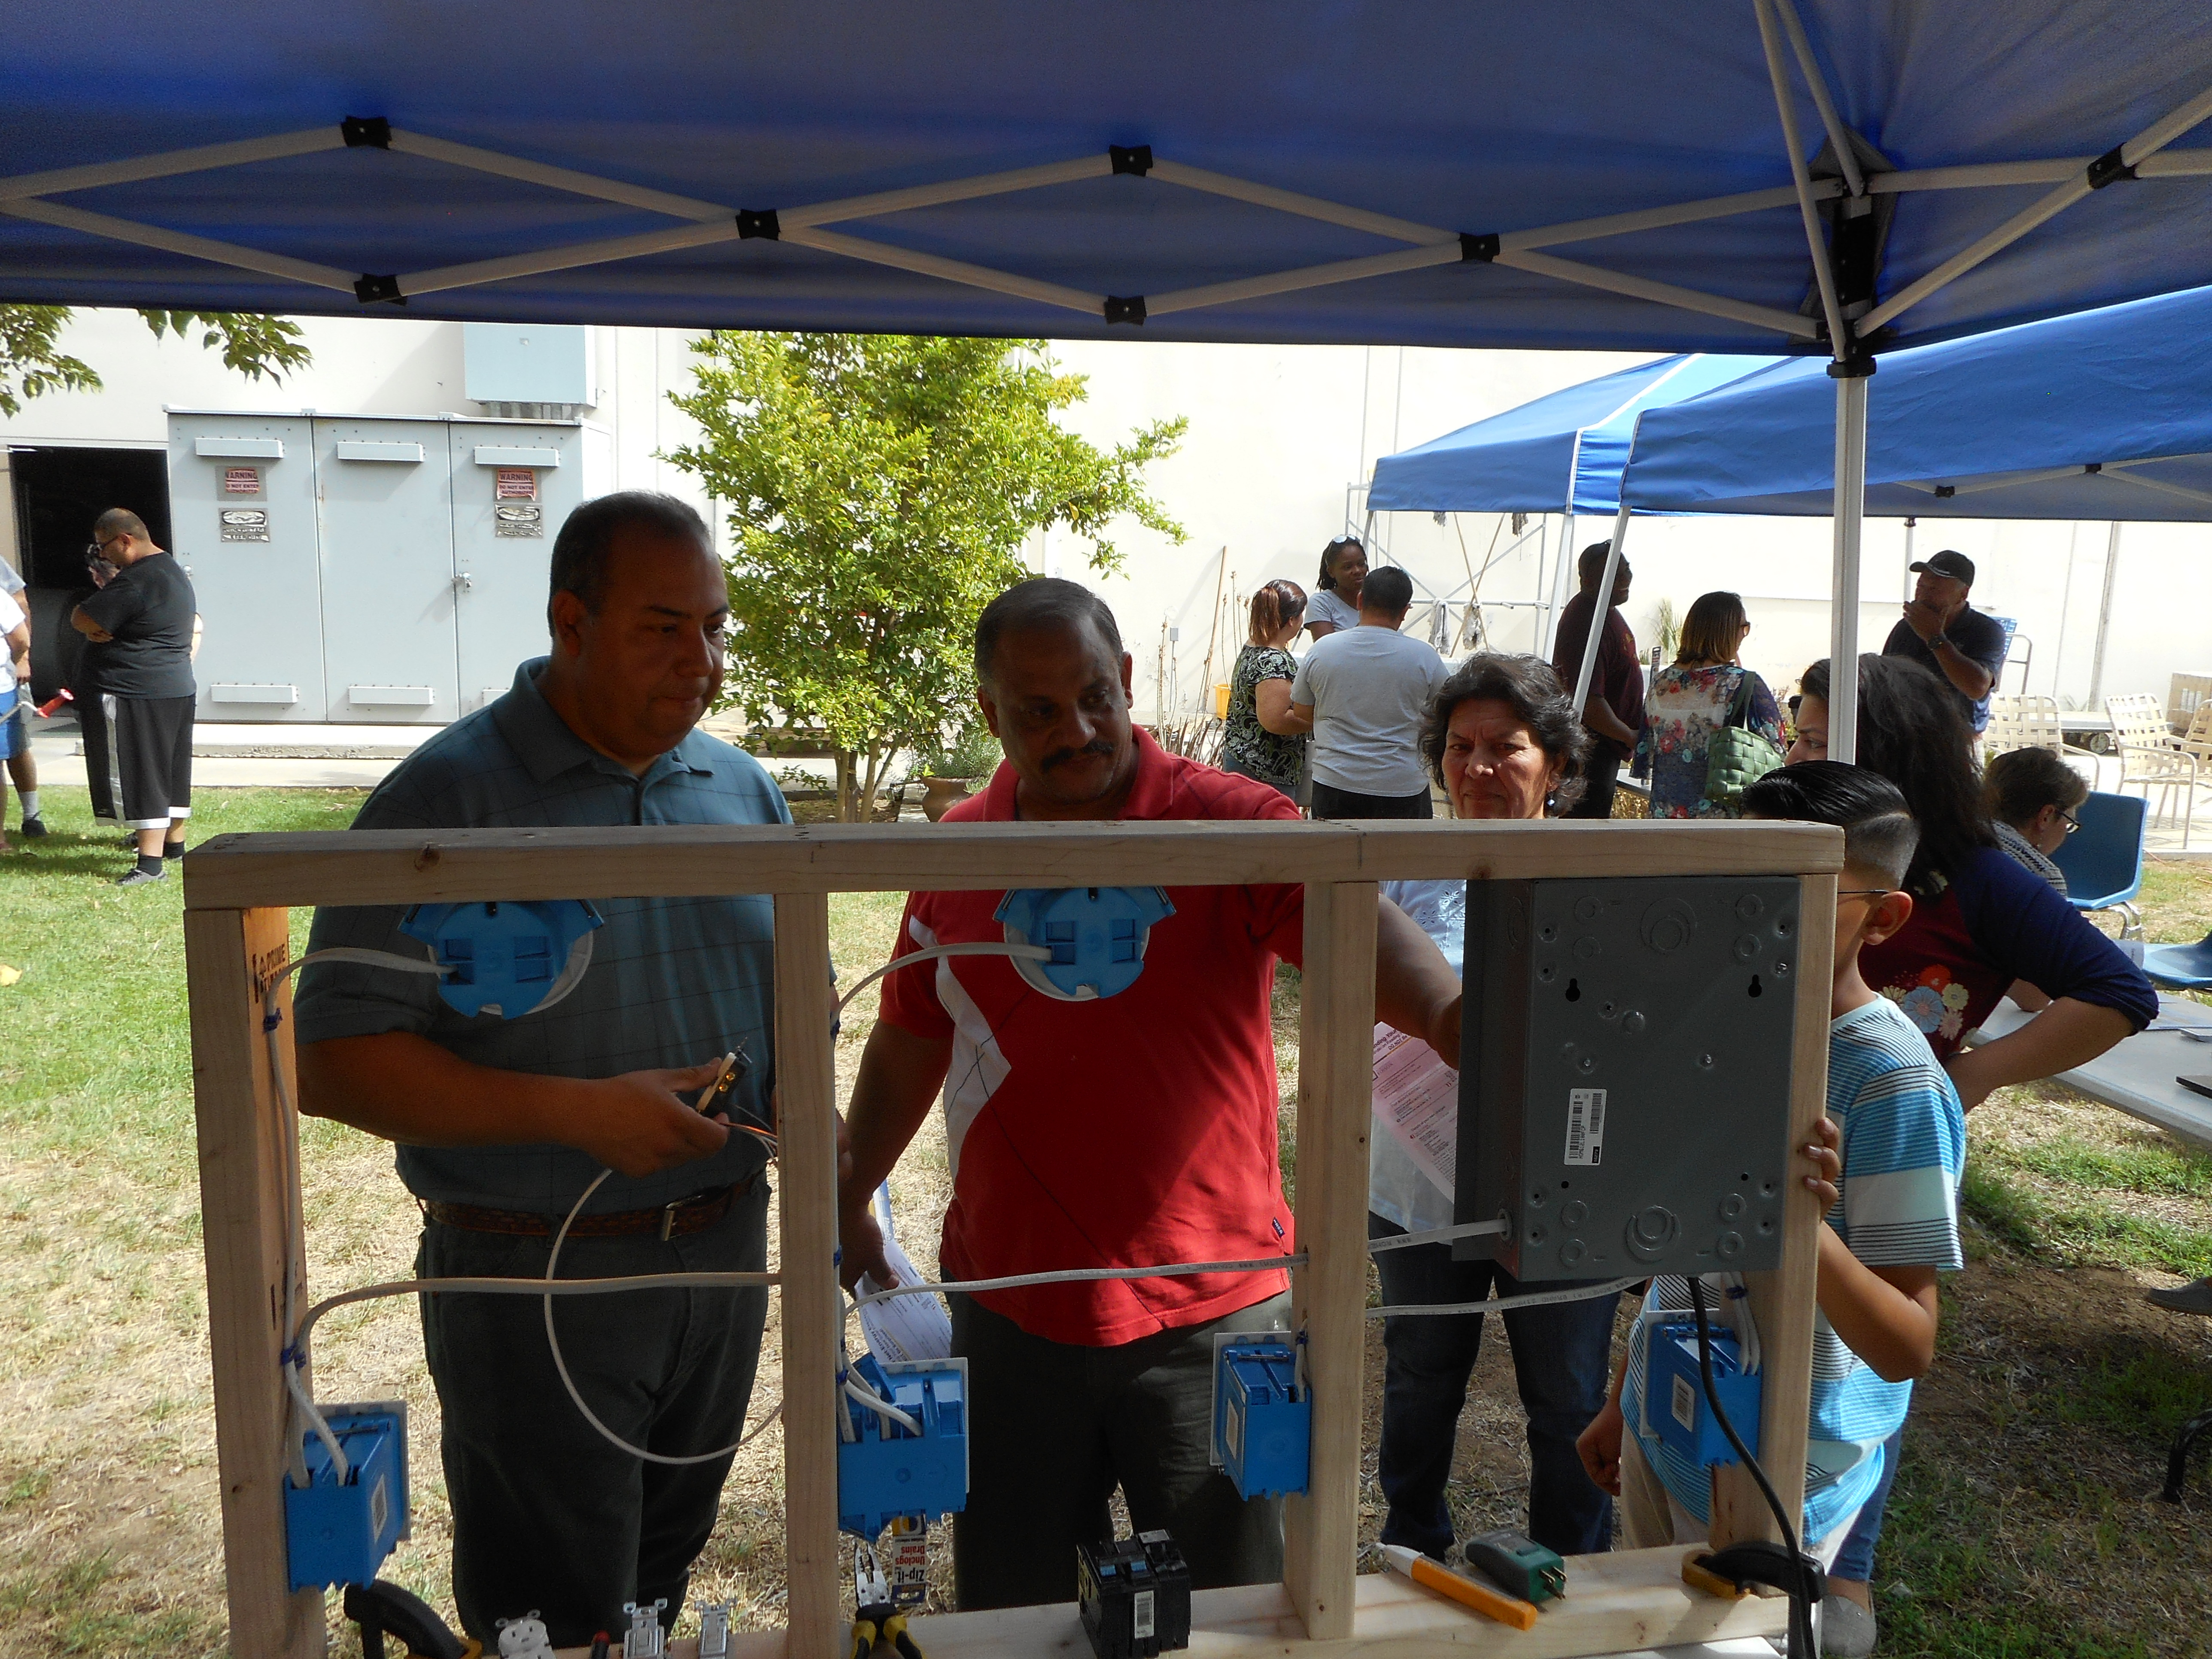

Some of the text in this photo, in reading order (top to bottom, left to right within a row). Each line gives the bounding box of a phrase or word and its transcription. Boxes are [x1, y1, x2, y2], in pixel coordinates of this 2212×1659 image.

[1394, 1038, 1403, 1046] NOT
[901, 1546, 925, 1555] Drains
[895, 1555, 925, 1566] Unclogs
